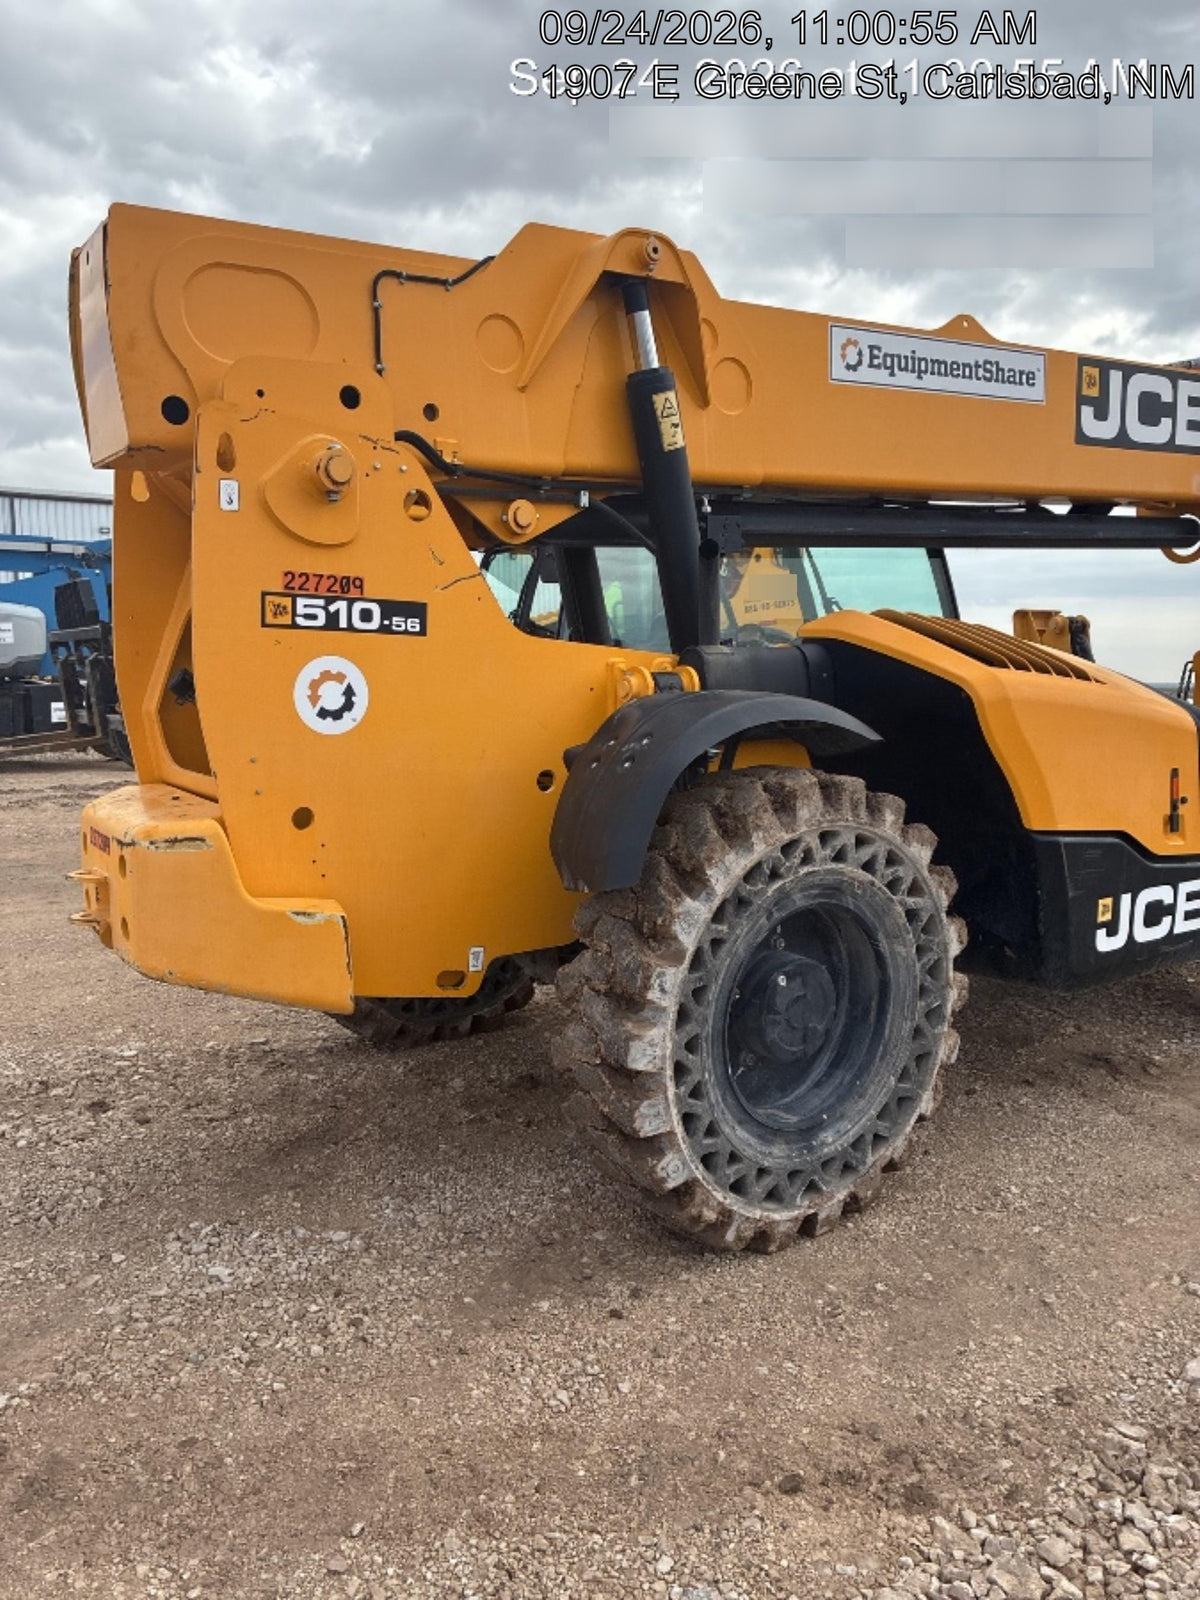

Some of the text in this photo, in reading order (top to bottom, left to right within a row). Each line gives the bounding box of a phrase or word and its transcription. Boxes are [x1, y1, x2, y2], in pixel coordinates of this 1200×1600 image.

[867, 343, 1036, 388] EquipmentShare
[283, 571, 365, 596] 227209
[295, 597, 421, 632] 510-56
